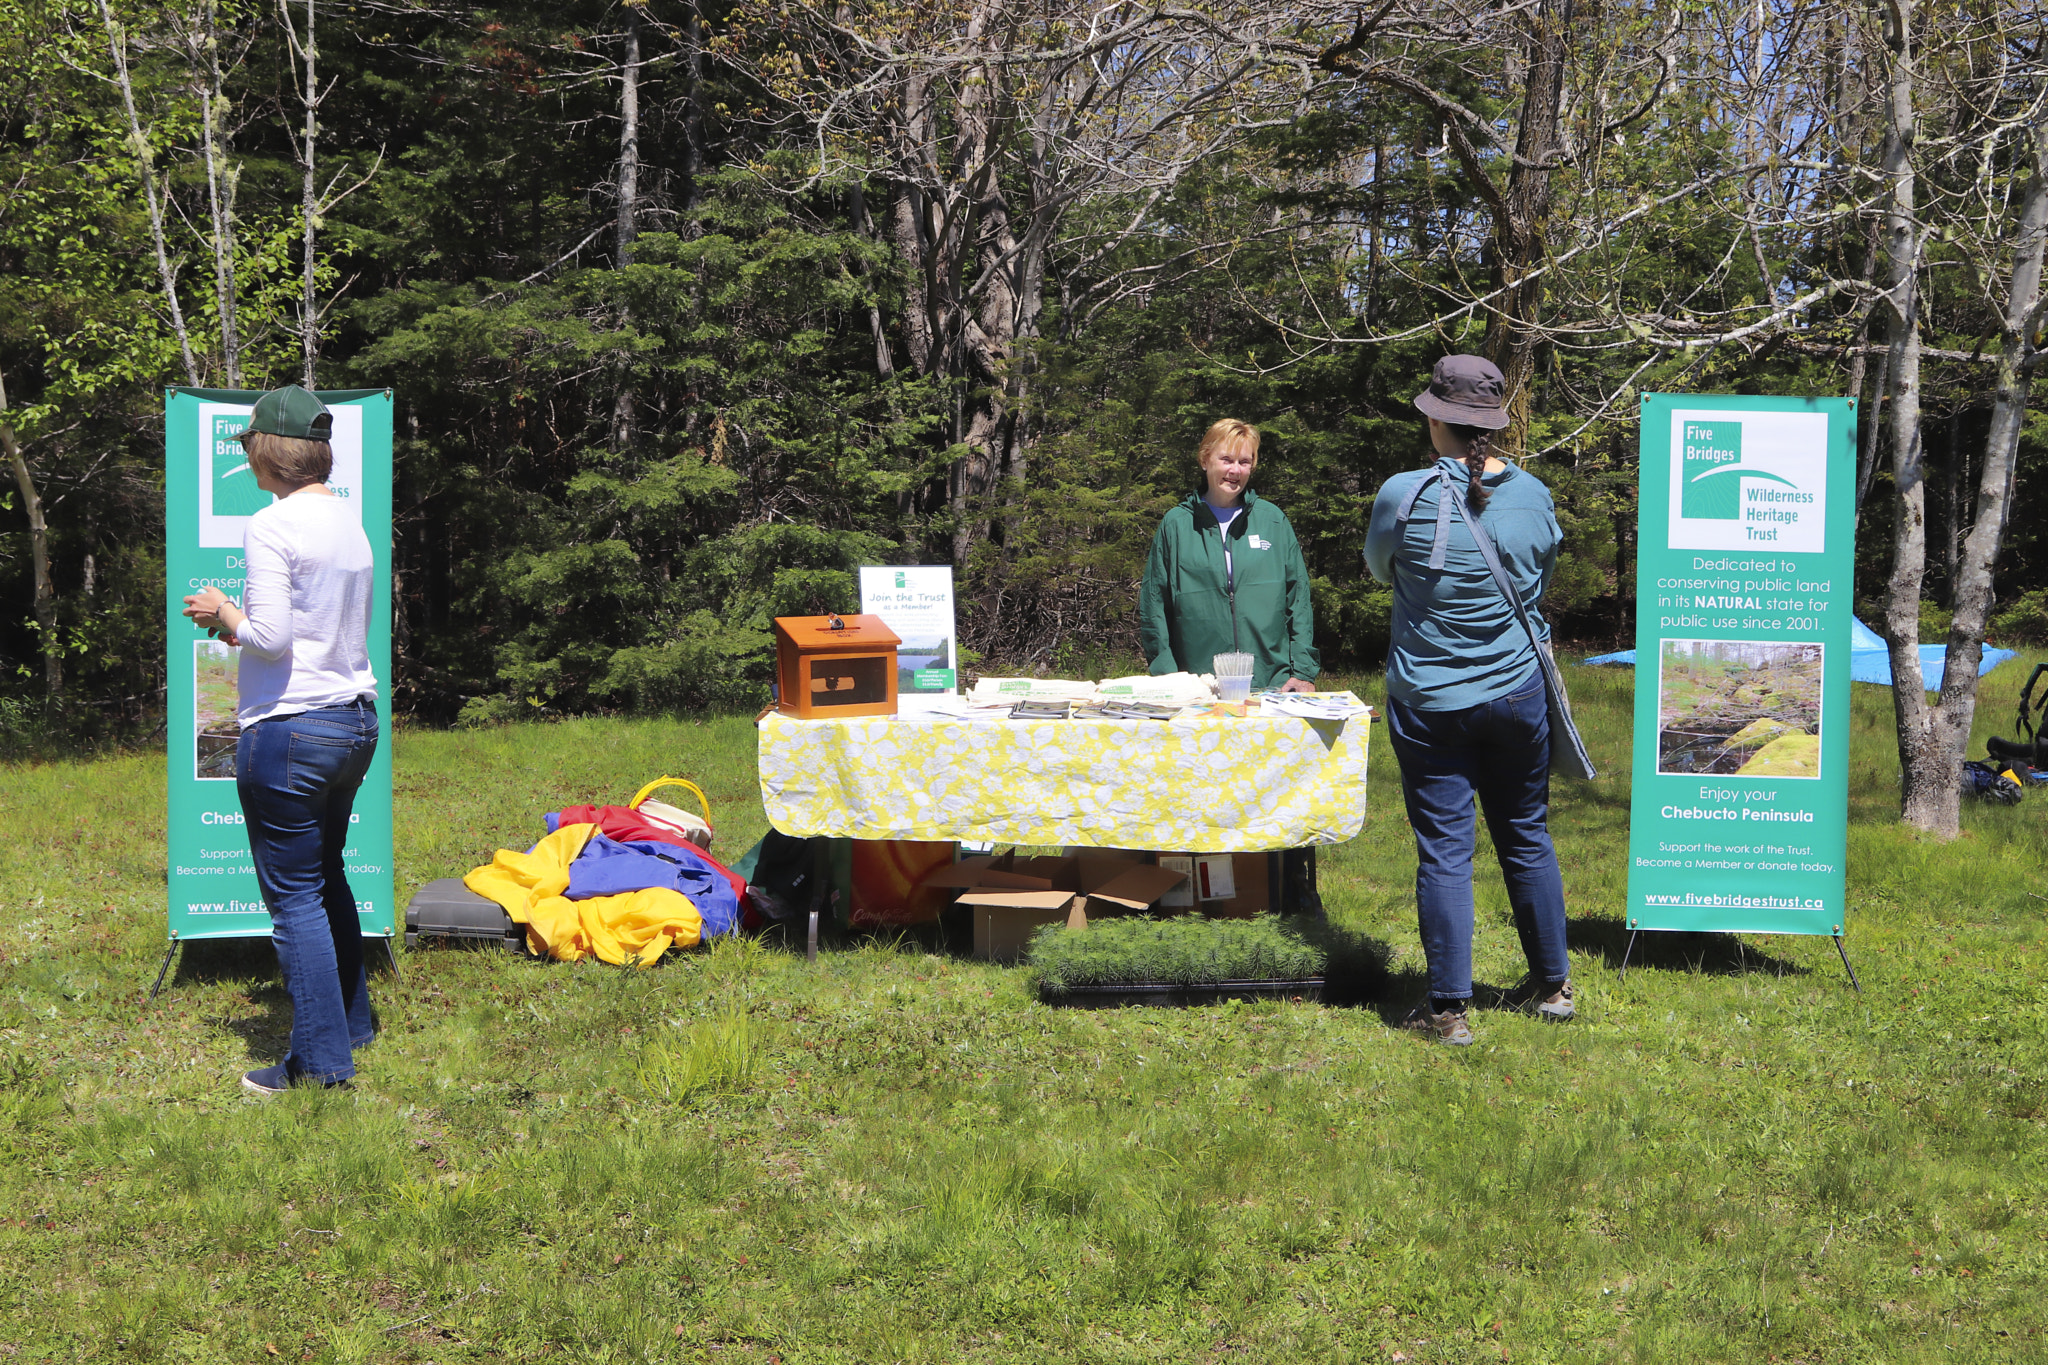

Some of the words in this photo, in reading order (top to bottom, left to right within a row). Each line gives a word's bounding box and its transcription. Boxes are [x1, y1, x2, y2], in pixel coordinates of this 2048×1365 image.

[216, 420, 243, 434] Five
[1686, 426, 1713, 440] Five
[1686, 446, 1735, 463] Bridges
[1747, 488, 1814, 503] Wilderness
[1746, 508, 1798, 525] Heritage
[1746, 526, 1778, 541] Trust
[1693, 557, 1776, 572] Dedicated
[1780, 560, 1796, 572] to
[1657, 577, 1740, 592] conserving
[1745, 578, 1792, 593] public
[1796, 579, 1831, 592] land
[869, 592, 892, 601] Join
[896, 593, 913, 601] the
[917, 593, 946, 601] Trust
[1658, 594, 1671, 607] in
[1675, 595, 1690, 608] its
[1695, 595, 1762, 609] NATURAL
[1766, 597, 1804, 611] state
[1808, 598, 1829, 612] for
[1660, 614, 1708, 629] public
[1712, 617, 1738, 628] use
[1742, 616, 1782, 629] since
[1786, 617, 1825, 631] 2001.
[1699, 786, 1740, 803] Enjoy
[1743, 790, 1777, 803] your
[201, 811, 245, 825] Cheb
[1661, 805, 1737, 820] Chebucto
[1742, 807, 1814, 822] Peninsula
[200, 848, 244, 860] Support
[1659, 841, 1701, 853] Support
[1704, 843, 1722, 853] the
[1724, 844, 1750, 854] work
[1753, 844, 1764, 854] of
[1767, 845, 1785, 854] the
[1787, 845, 1814, 855] Trust.
[176, 865, 224, 875] Become
[348, 864, 385, 875] today.
[1636, 857, 1682, 867] Become
[1695, 859, 1741, 869] Member
[1744, 862, 1755, 870] or
[1757, 860, 1798, 871] donate
[1800, 861, 1836, 874] today.
[1645, 893, 1824, 909] www.fivebridgestrust.ca
